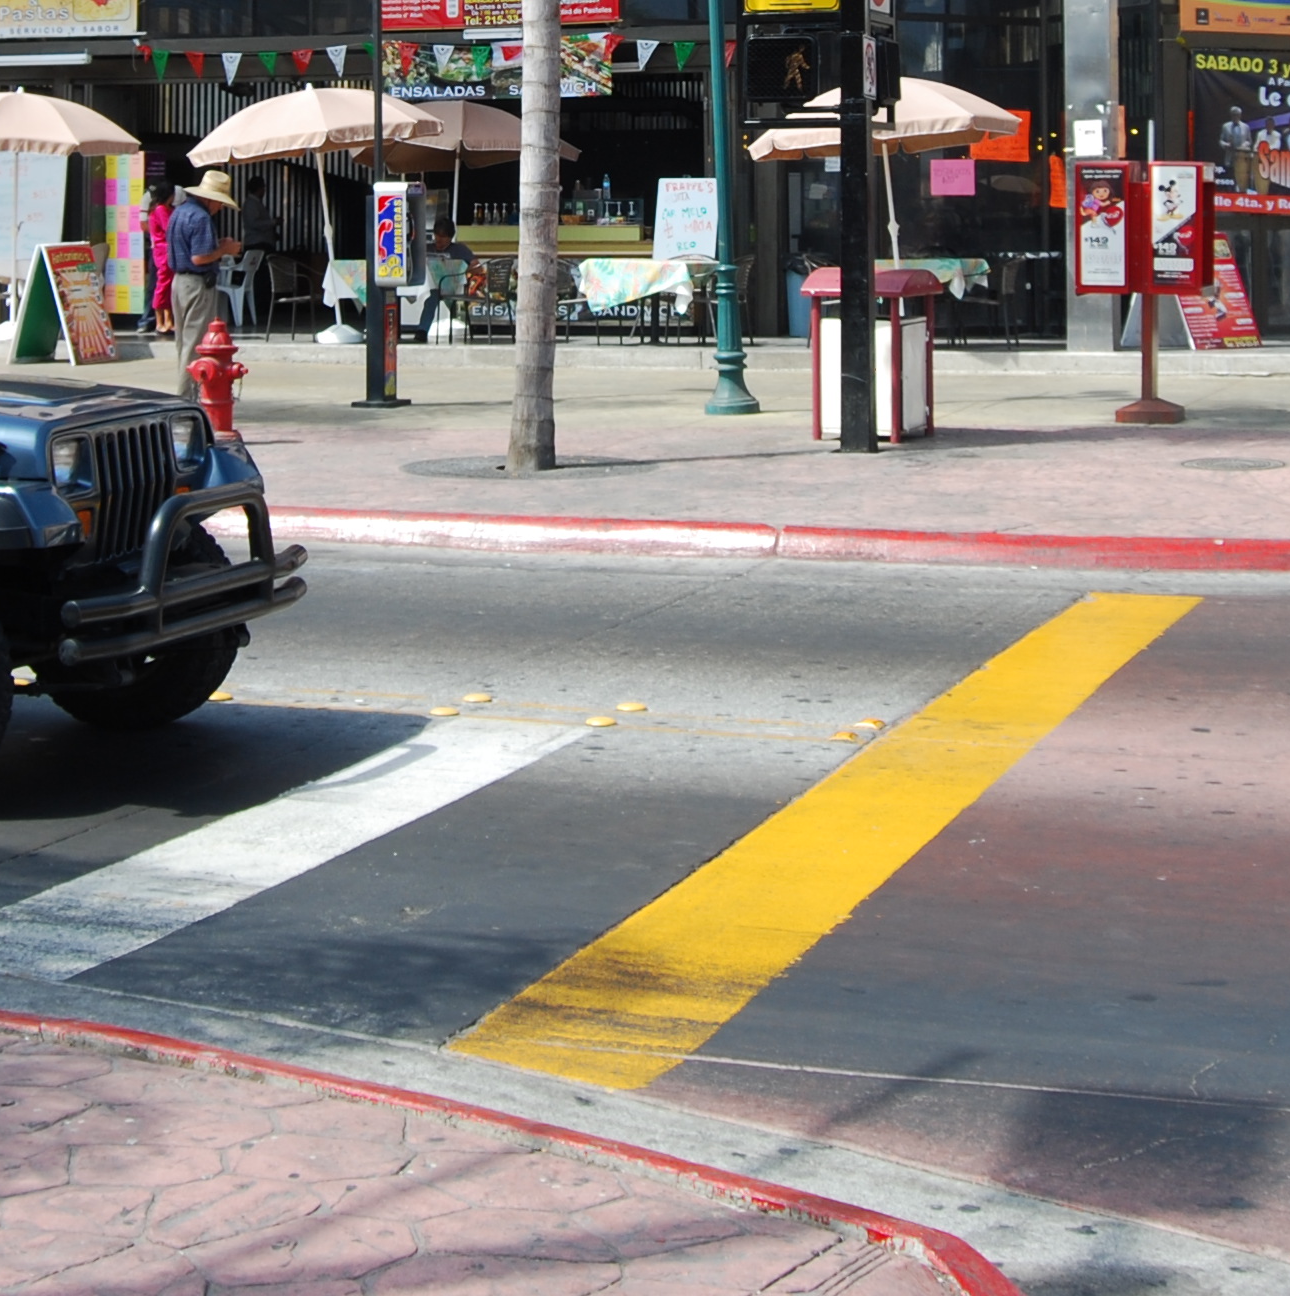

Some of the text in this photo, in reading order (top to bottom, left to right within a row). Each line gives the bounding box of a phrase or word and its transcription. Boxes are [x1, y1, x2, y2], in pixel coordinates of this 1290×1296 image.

[9, 26, 64, 35] SERVICIO
[83, 24, 120, 34] SABOR
[1195, 53, 1264, 73] SABADO
[1268, 59, 1279, 74] 3
[1268, 77, 1276, 86] A
[391, 85, 486, 98] ENSALADAS
[1259, 86, 1282, 107] Le
[1235, 197, 1263, 209] 4ta.
[1266, 200, 1274, 212] y
[393, 198, 403, 255] MONEDAS
